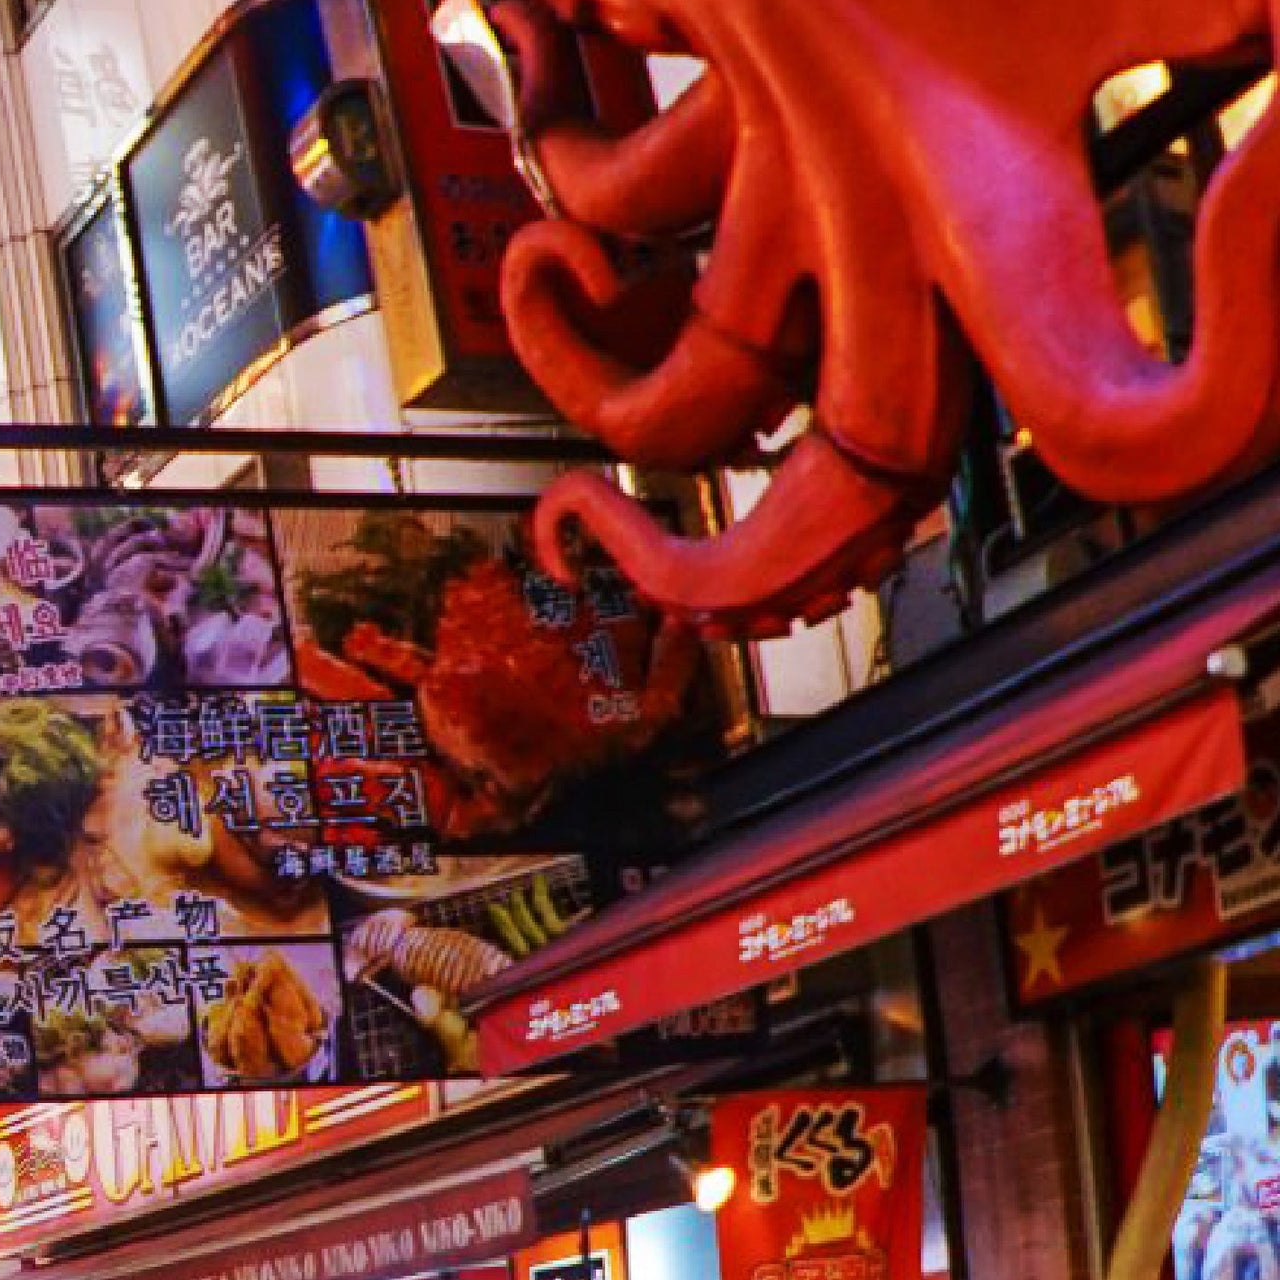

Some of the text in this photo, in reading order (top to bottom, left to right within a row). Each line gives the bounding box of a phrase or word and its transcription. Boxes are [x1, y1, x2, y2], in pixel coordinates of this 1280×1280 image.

[187, 198, 238, 278] BAR
[772, 1104, 876, 1194] くくる
